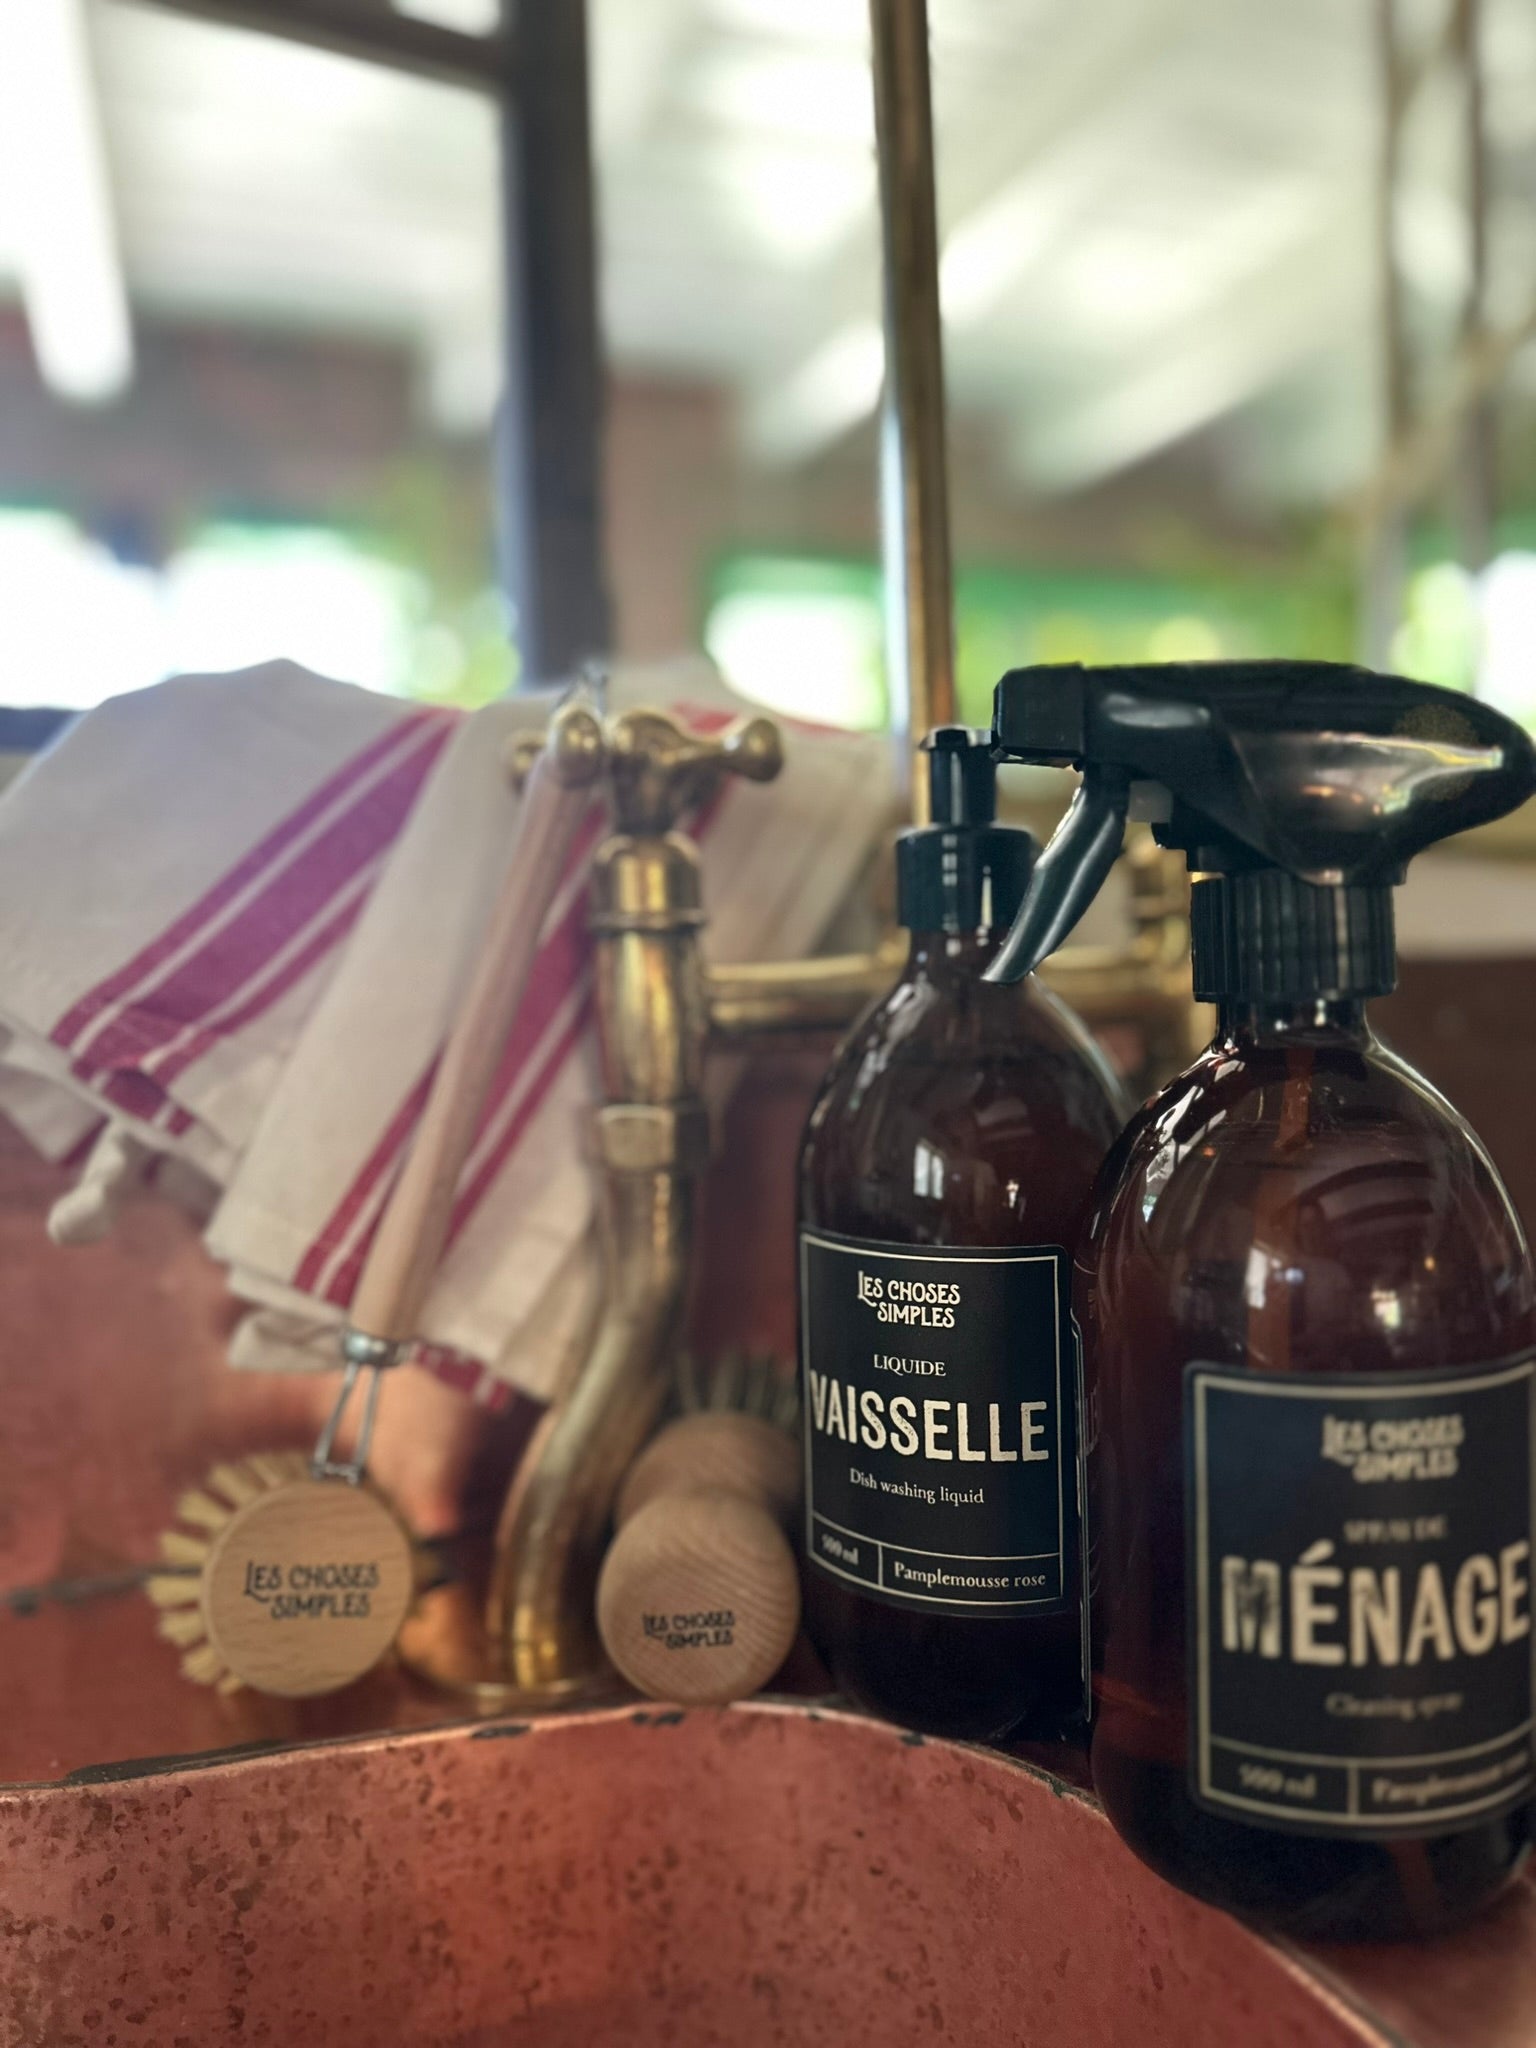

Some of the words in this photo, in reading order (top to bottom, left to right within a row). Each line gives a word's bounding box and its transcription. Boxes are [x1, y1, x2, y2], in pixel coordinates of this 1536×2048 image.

[857, 1270, 883, 1308] LES
[887, 1279, 961, 1305] CHOSES
[877, 1301, 955, 1328] SIMPLES
[873, 1353, 947, 1377] LIQUIDE
[809, 1369, 1050, 1462] VAISSELLE
[1320, 1414, 1368, 1466] LES
[1369, 1413, 1466, 1451] CHOSES
[1352, 1448, 1459, 1484] SIMPLES
[849, 1467, 878, 1491] Dish
[880, 1480, 936, 1505] washing
[940, 1486, 985, 1508] liquid
[244, 1560, 282, 1604] LES
[289, 1561, 381, 1590] CHOSES
[893, 1560, 1010, 1589] Pamplemousse
[1013, 1571, 1046, 1588] rose
[271, 1592, 371, 1620] SIMPLES
[1221, 1538, 1531, 1667] MÉNAGE
[642, 1611, 669, 1642] LES
[672, 1609, 735, 1631] CHOSES
[665, 1629, 734, 1651] SIMPLES
